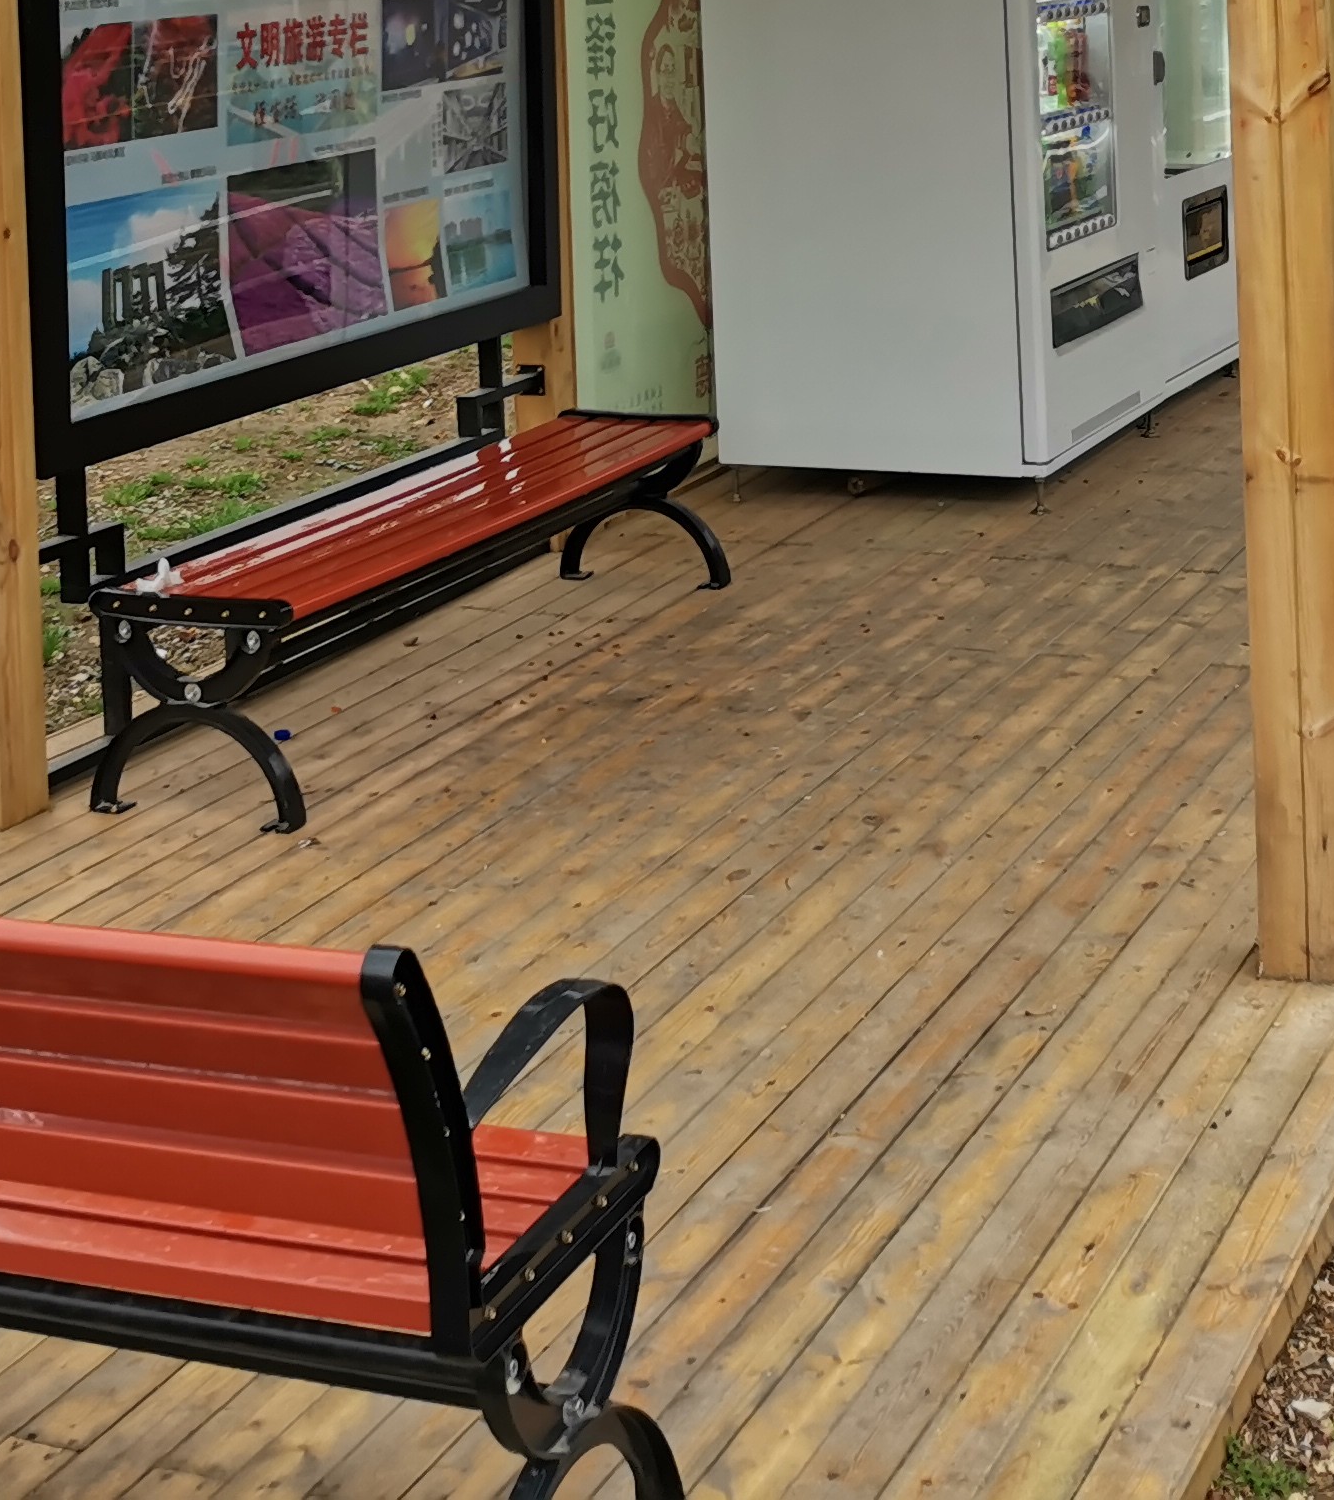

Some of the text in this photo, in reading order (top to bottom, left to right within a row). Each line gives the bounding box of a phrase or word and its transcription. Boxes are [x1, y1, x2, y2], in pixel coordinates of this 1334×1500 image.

[235, 11, 369, 70] 文明旅游专栏
